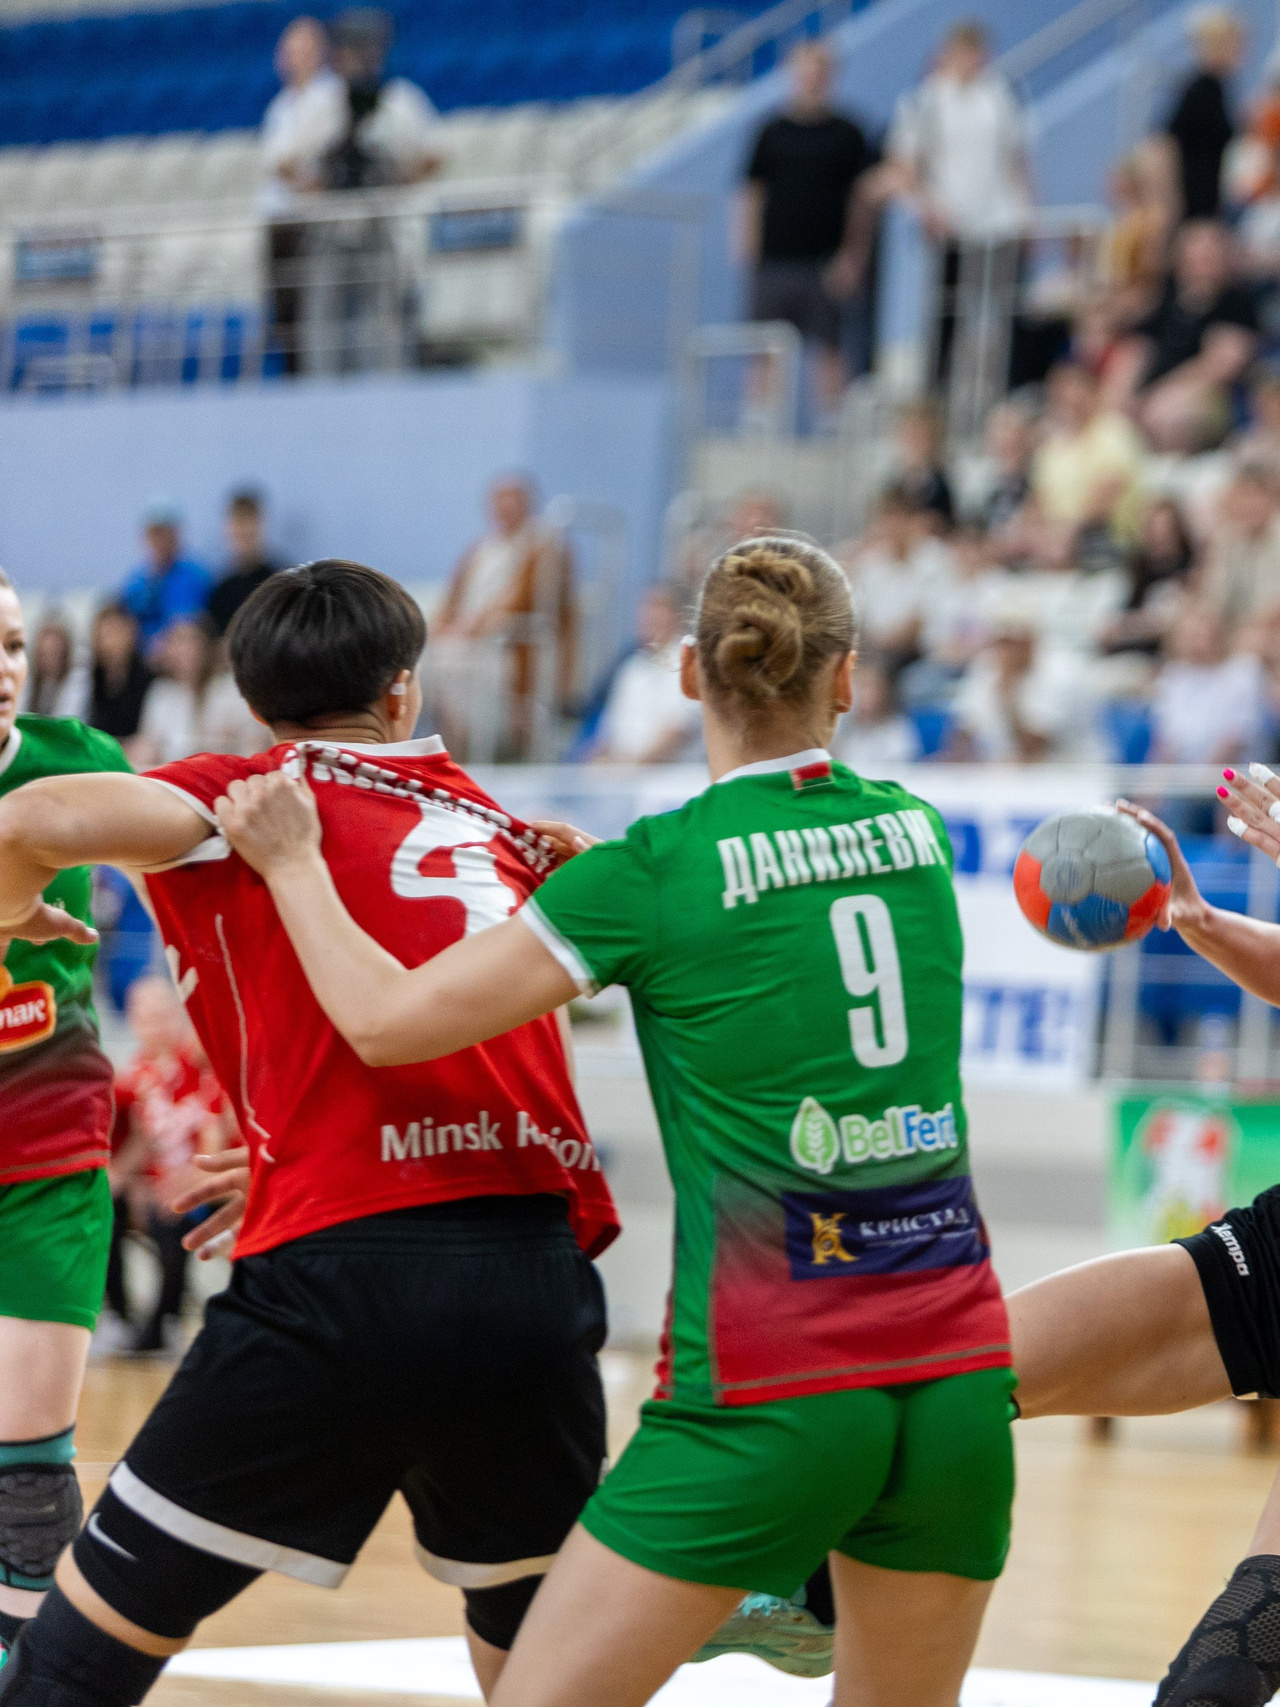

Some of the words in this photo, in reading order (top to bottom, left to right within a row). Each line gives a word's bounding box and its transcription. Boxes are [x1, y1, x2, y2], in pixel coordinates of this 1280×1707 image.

[829, 894, 909, 1068] 9
[380, 1110, 503, 1162] Minsk
[839, 1102, 958, 1163] BelFert
[1210, 1222, 1250, 1277] Kempa
